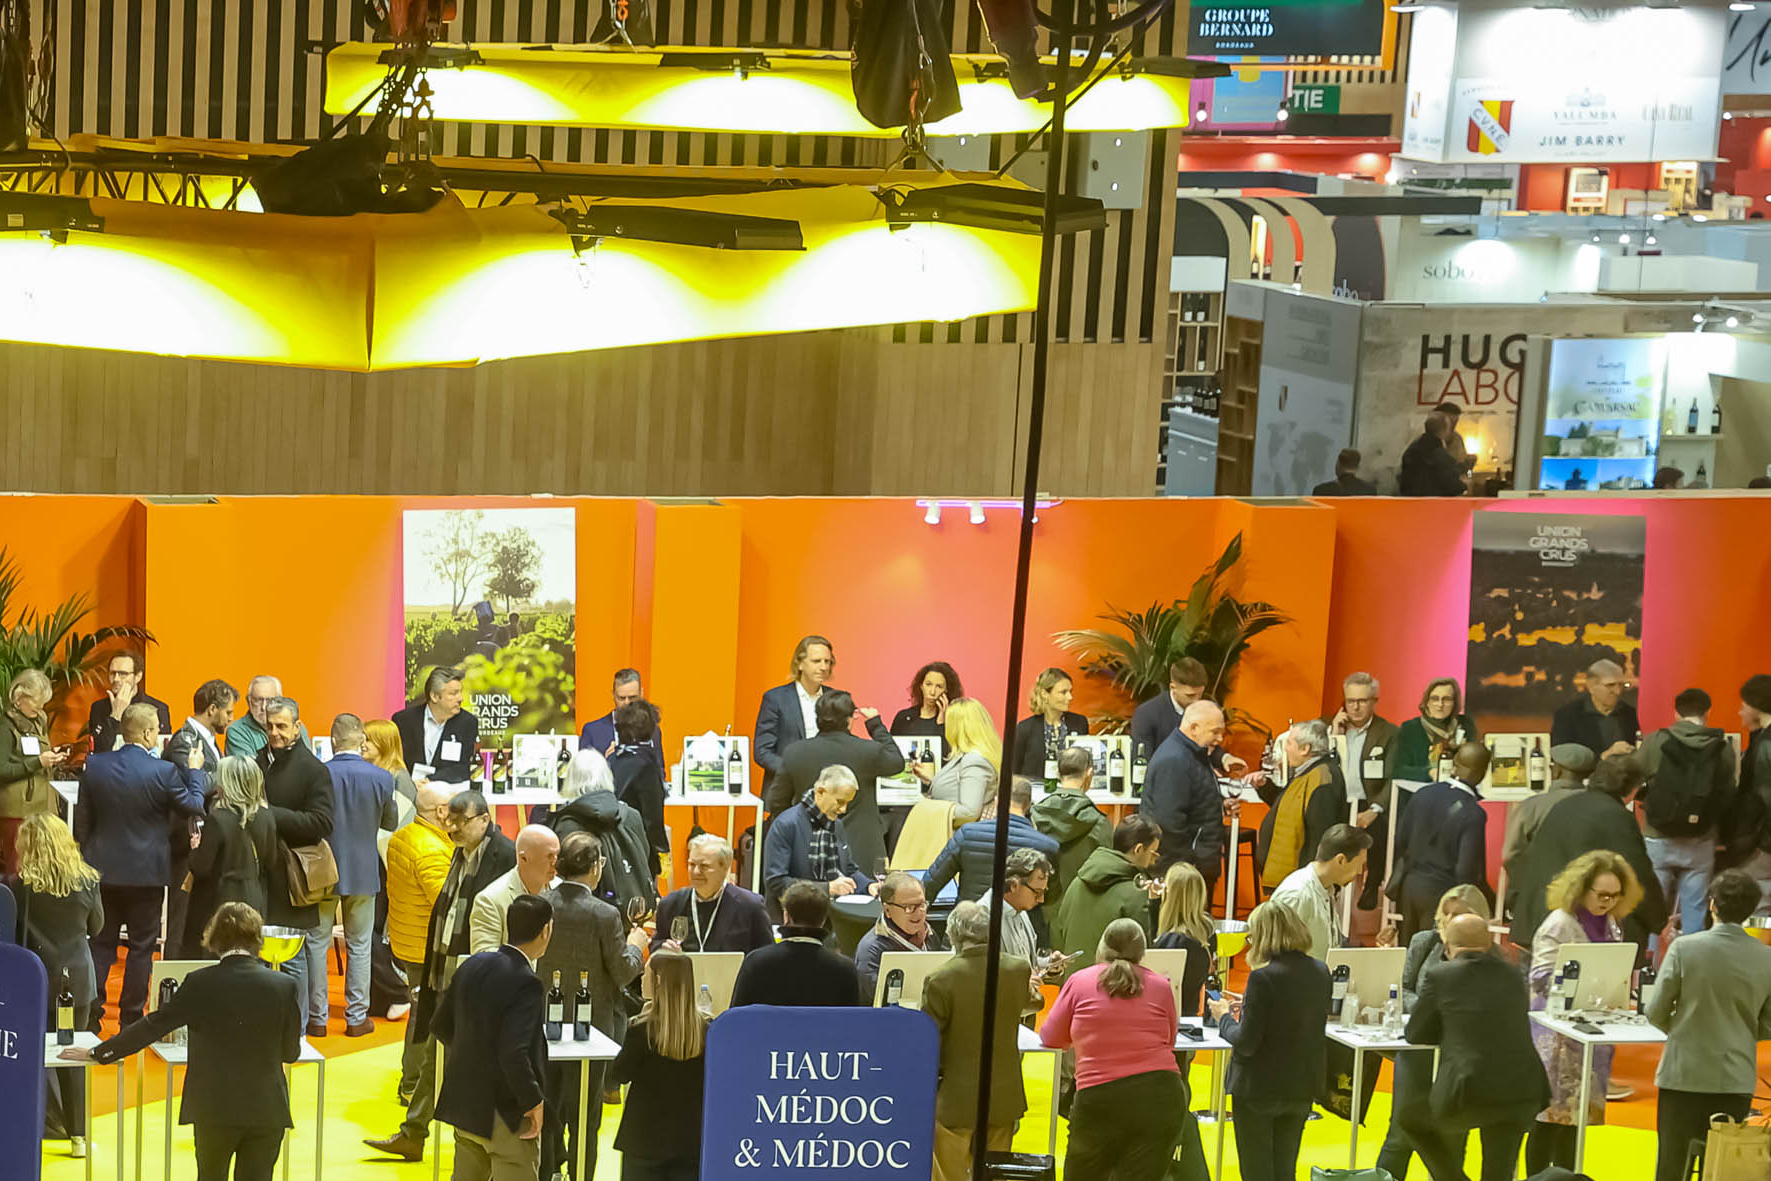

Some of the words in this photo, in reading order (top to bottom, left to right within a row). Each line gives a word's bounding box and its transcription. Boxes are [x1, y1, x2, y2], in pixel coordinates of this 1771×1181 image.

[1204, 8, 1271, 23] GROUPE
[1198, 23, 1274, 38] BERNARD
[1287, 89, 1324, 109] TIE
[1539, 135, 1567, 147] JIM
[1575, 135, 1626, 147] BARRY
[1536, 526, 1582, 538] UNION
[1529, 536, 1589, 550] GRANDS
[1539, 549, 1577, 562] CRUS
[469, 694, 512, 706] UNION
[468, 705, 519, 717] RANDS
[769, 1051, 882, 1080] HAUT-
[755, 1088, 894, 1125] MÉDOC
[733, 1138, 761, 1168] &
[772, 1132, 911, 1169] MÉDOC
